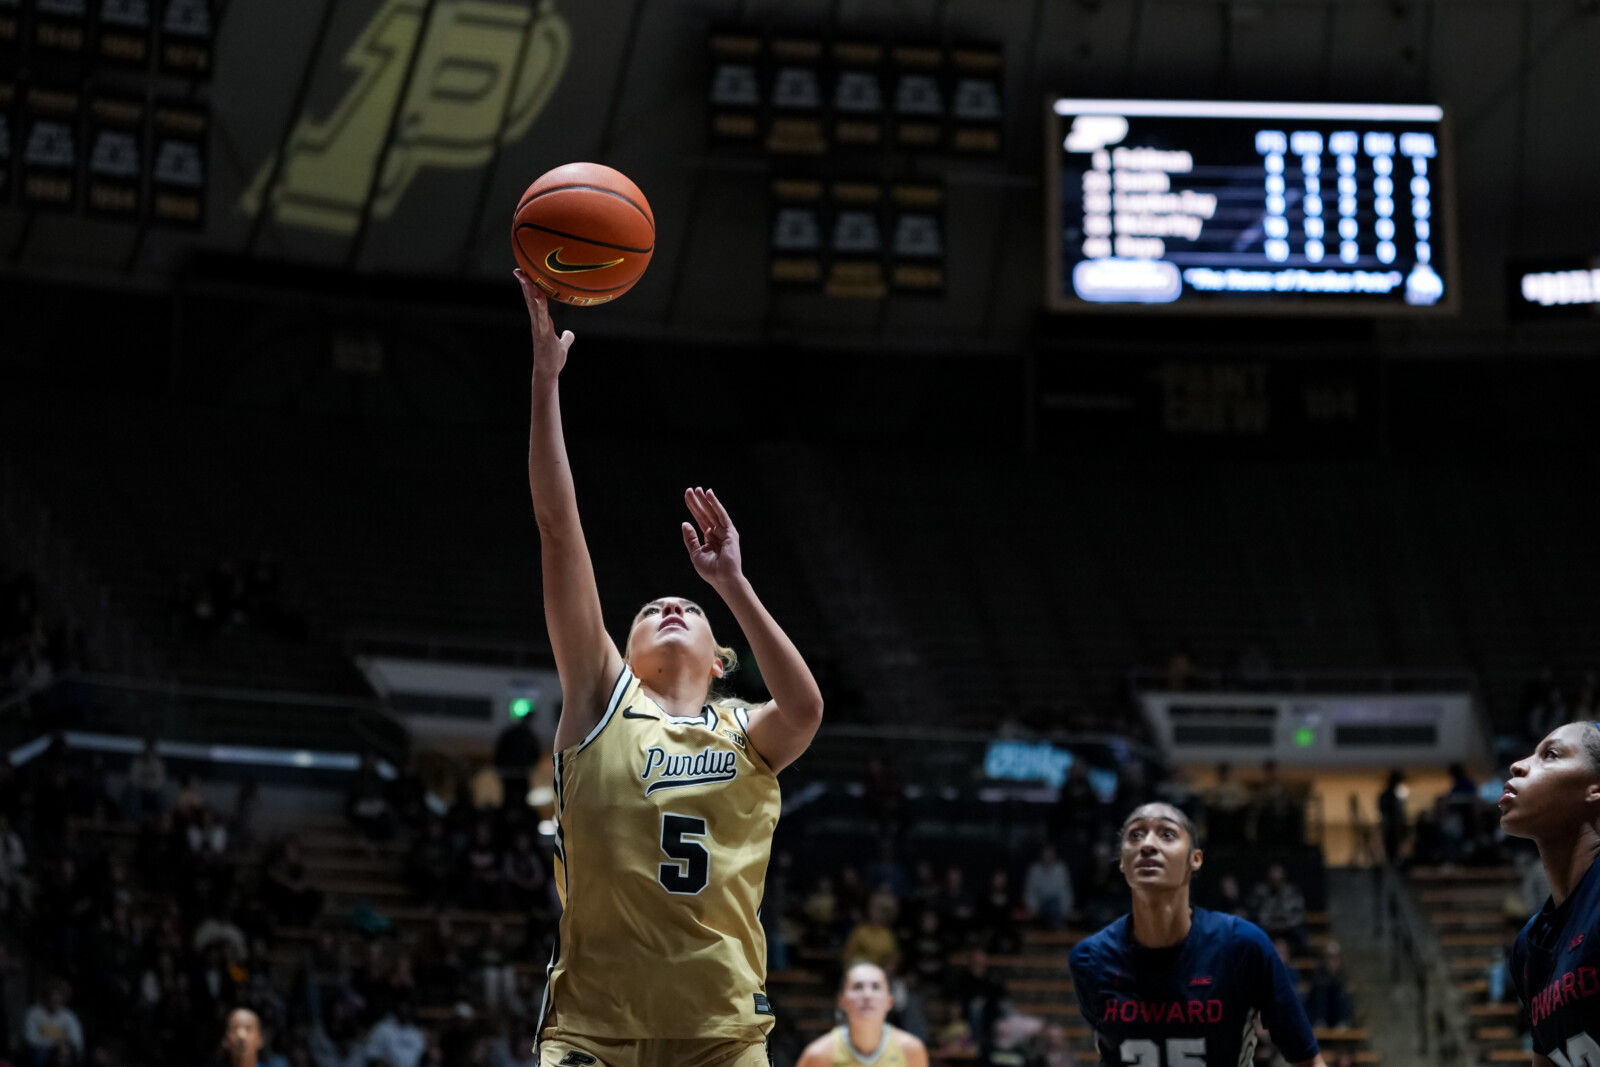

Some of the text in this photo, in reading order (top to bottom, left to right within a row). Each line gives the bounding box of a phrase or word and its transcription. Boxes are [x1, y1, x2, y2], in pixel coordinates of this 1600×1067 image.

[641, 747, 738, 795] Purdue
[658, 812, 711, 895] 5
[1103, 1000, 1223, 1023] HOWARD
